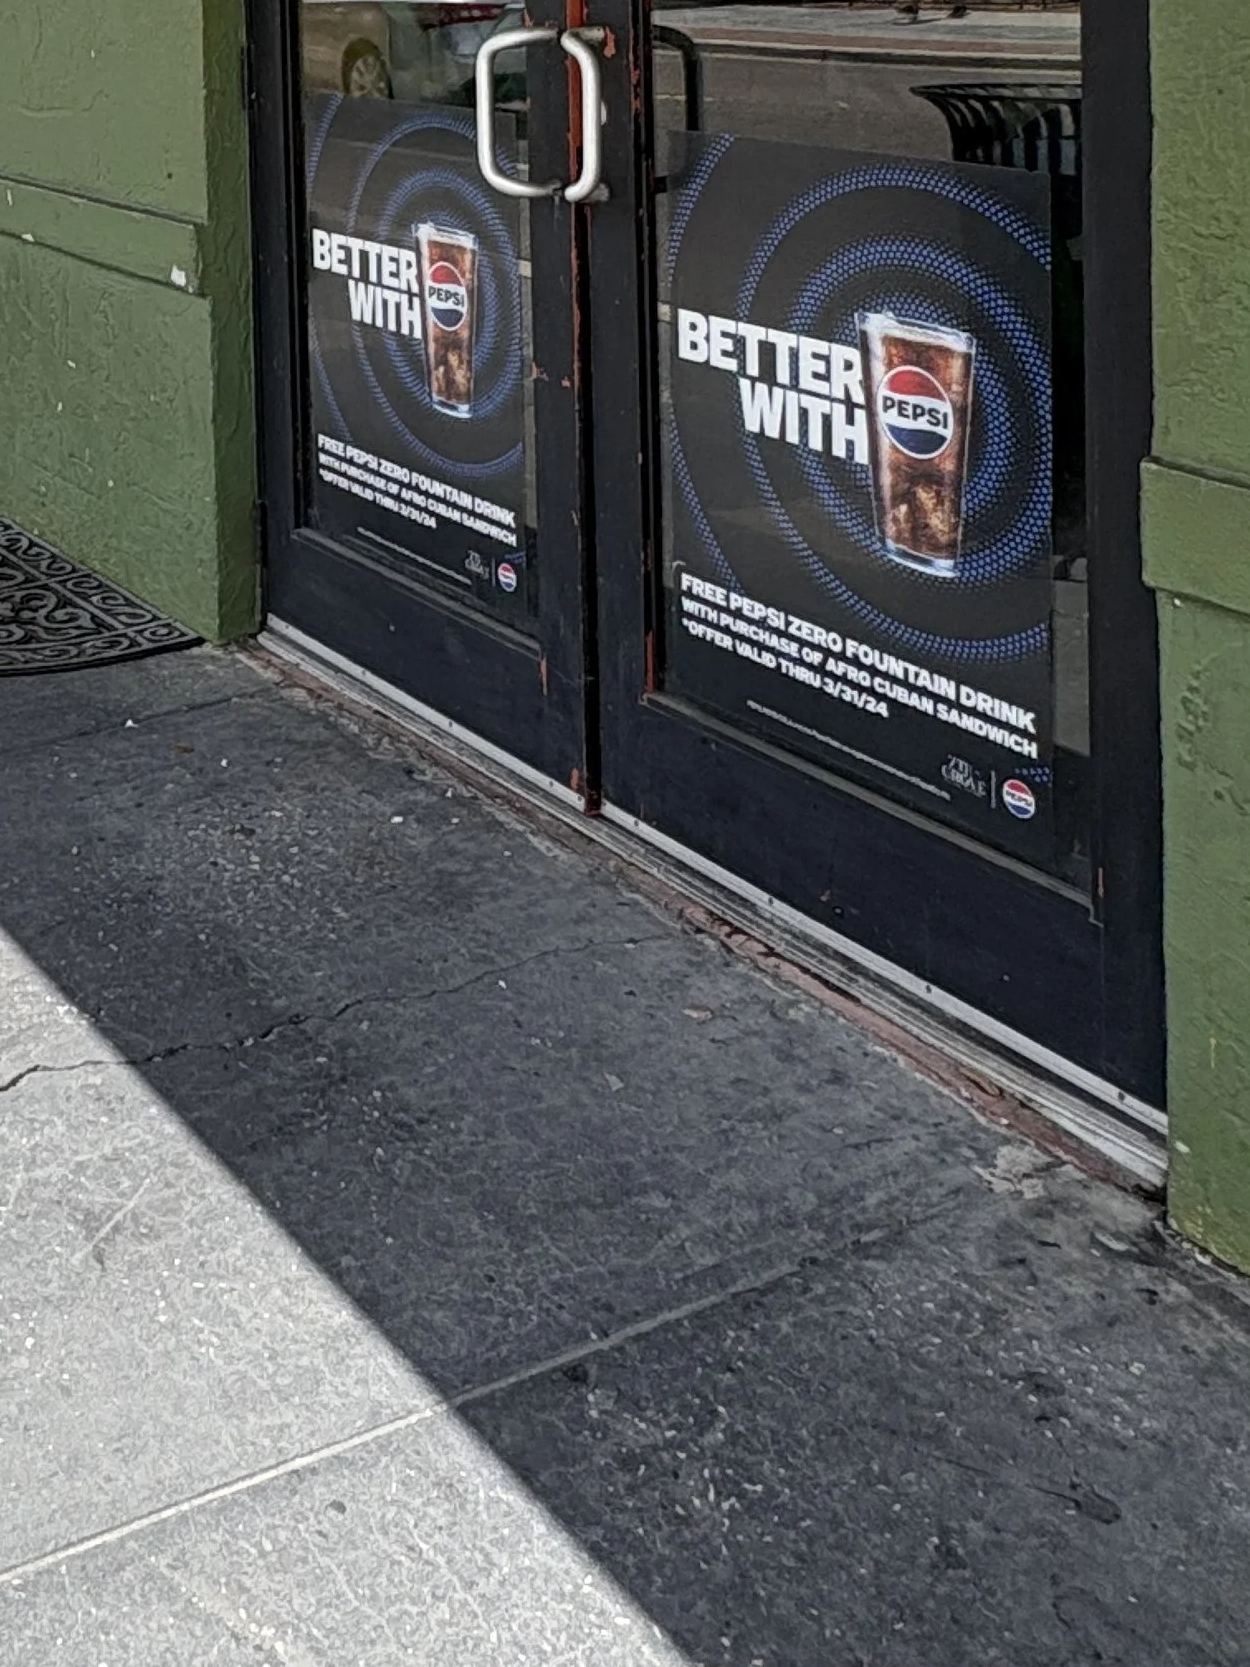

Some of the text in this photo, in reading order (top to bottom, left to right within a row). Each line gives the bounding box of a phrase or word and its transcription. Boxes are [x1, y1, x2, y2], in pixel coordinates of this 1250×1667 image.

[312, 228, 420, 294] BETTER
[428, 287, 465, 308] PEPSI
[348, 279, 423, 339] WITH
[677, 308, 866, 406] BETTER
[739, 377, 870, 465] WITH
[881, 395, 949, 430] PEPSI
[681, 572, 1036, 735] FREE PEPSI ZERO FOUNTAIN DRINK
[681, 596, 1037, 759] WITH PURCHASE OF AFRO CUBAN SANDWICH
[734, 639, 779, 669] VALID
[777, 657, 823, 688] THRU
[821, 677, 888, 718] 3/31/24
